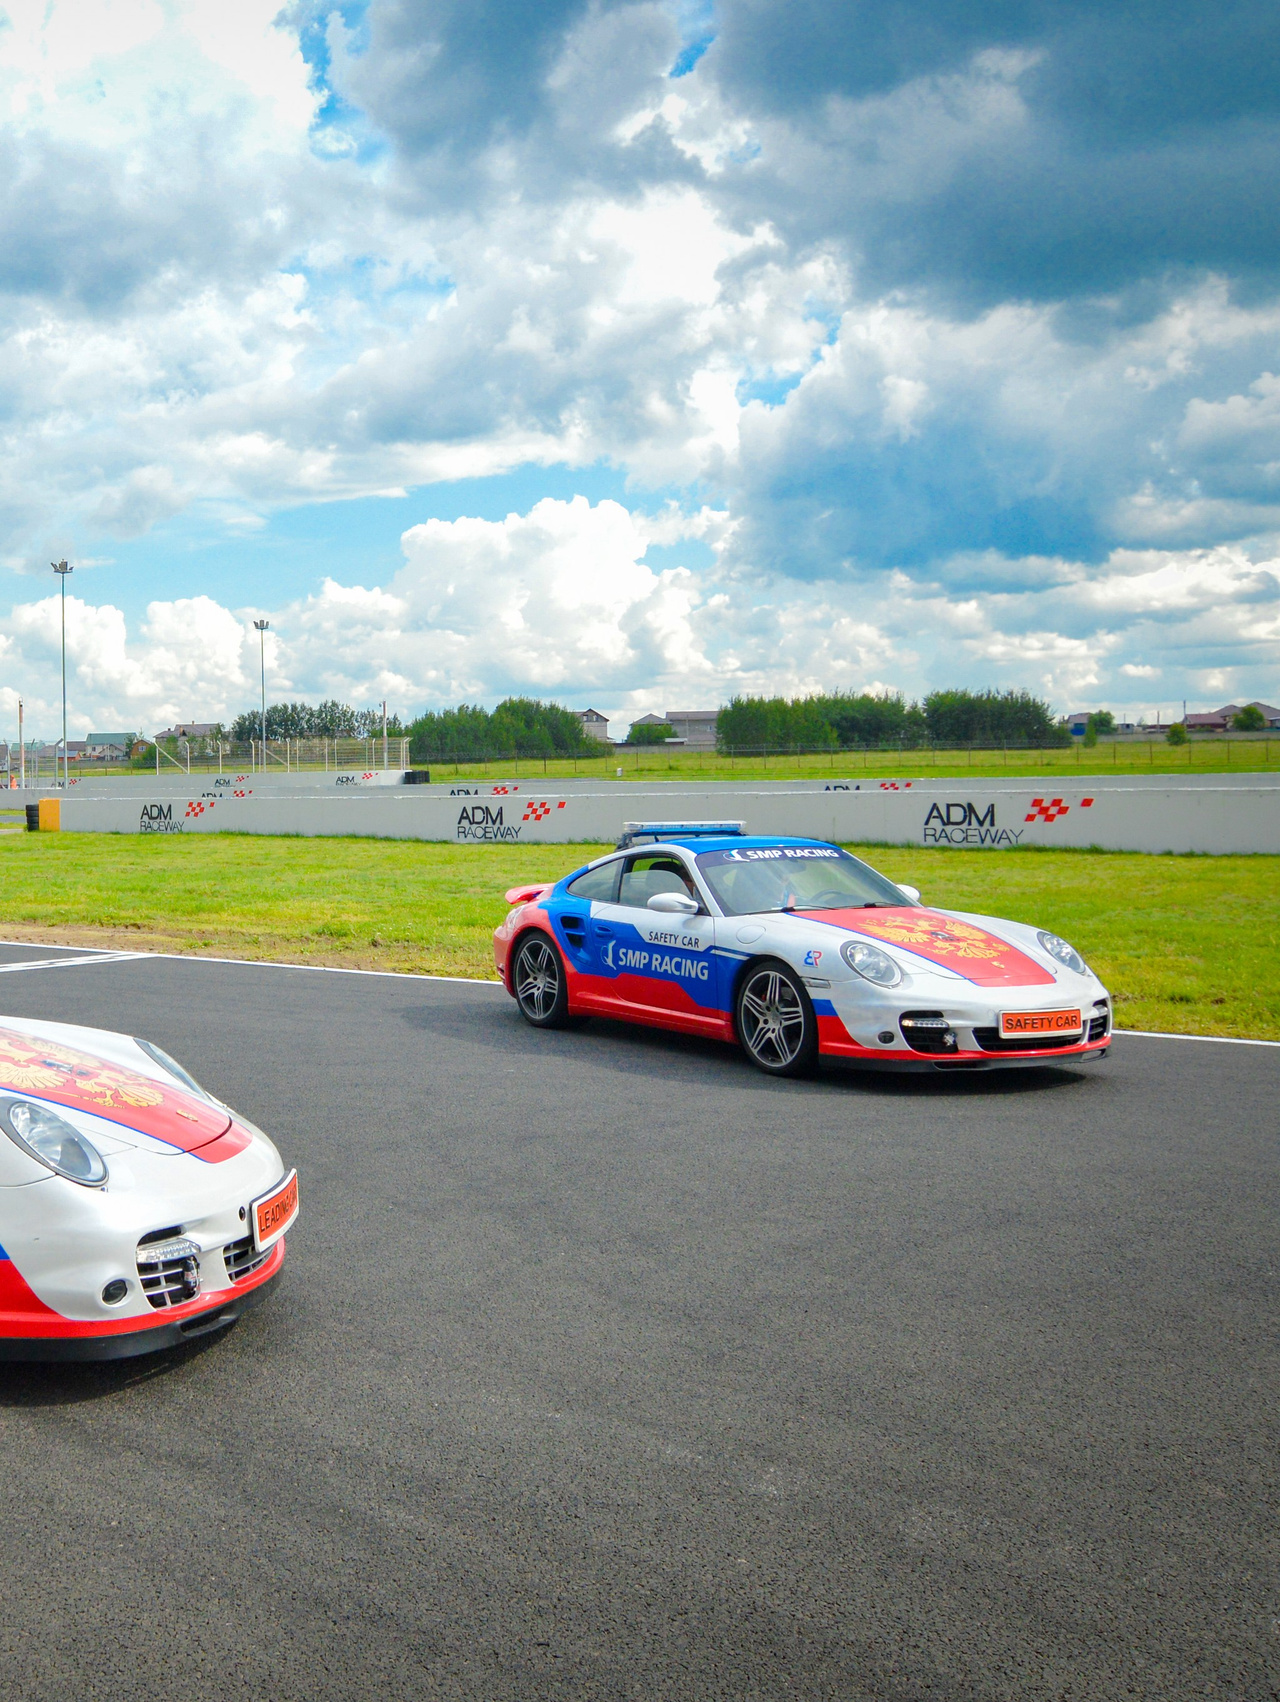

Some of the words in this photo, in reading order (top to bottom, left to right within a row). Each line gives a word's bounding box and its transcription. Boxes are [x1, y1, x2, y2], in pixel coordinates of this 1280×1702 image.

[141, 804, 172, 820] ADM
[458, 806, 503, 825] ADM
[924, 803, 995, 827] ADM
[140, 820, 185, 831] RACEWAY
[457, 826, 521, 840] RACEWAY
[924, 828, 1023, 845] RACEWAY
[749, 850, 782, 860] SMP
[787, 849, 839, 858] RACING
[649, 930, 679, 946] SAFETY
[682, 936, 700, 948] CAR
[618, 948, 648, 971] SMP
[651, 953, 709, 980] RACING
[1005, 1017, 1053, 1030] SAFETY
[1056, 1015, 1078, 1028] CAR
